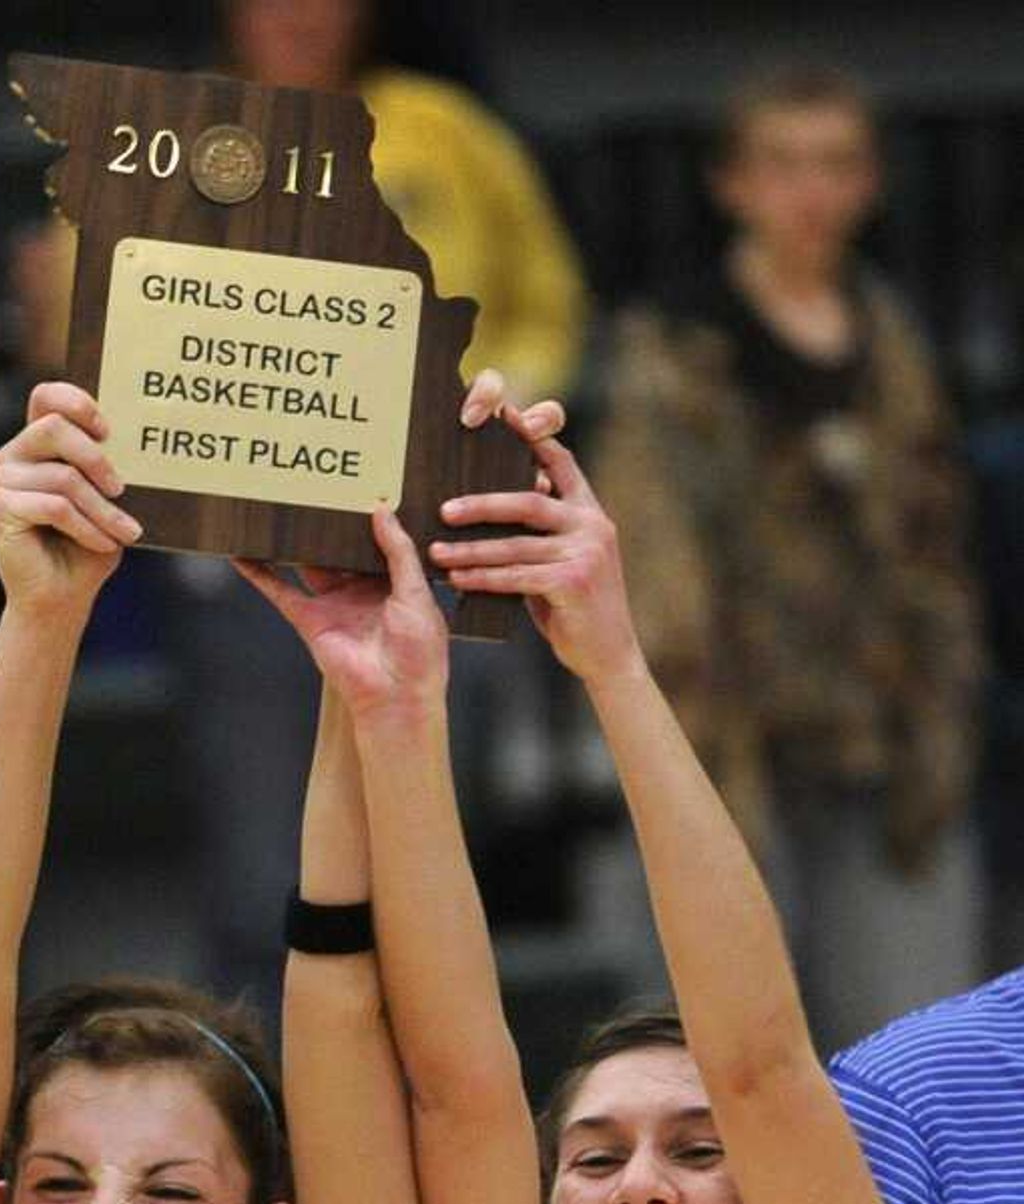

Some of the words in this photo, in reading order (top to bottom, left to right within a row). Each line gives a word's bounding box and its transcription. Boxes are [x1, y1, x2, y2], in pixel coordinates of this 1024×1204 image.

[107, 124, 180, 179] 20
[281, 145, 335, 198] 11
[141, 274, 244, 311] GIRLS
[253, 288, 367, 326] CLASS
[376, 302, 397, 330] 2
[180, 335, 342, 379] DISTRICT
[142, 371, 369, 423] BASKETBALL
[140, 426, 240, 462] FIRST
[248, 438, 362, 477] PLACE
